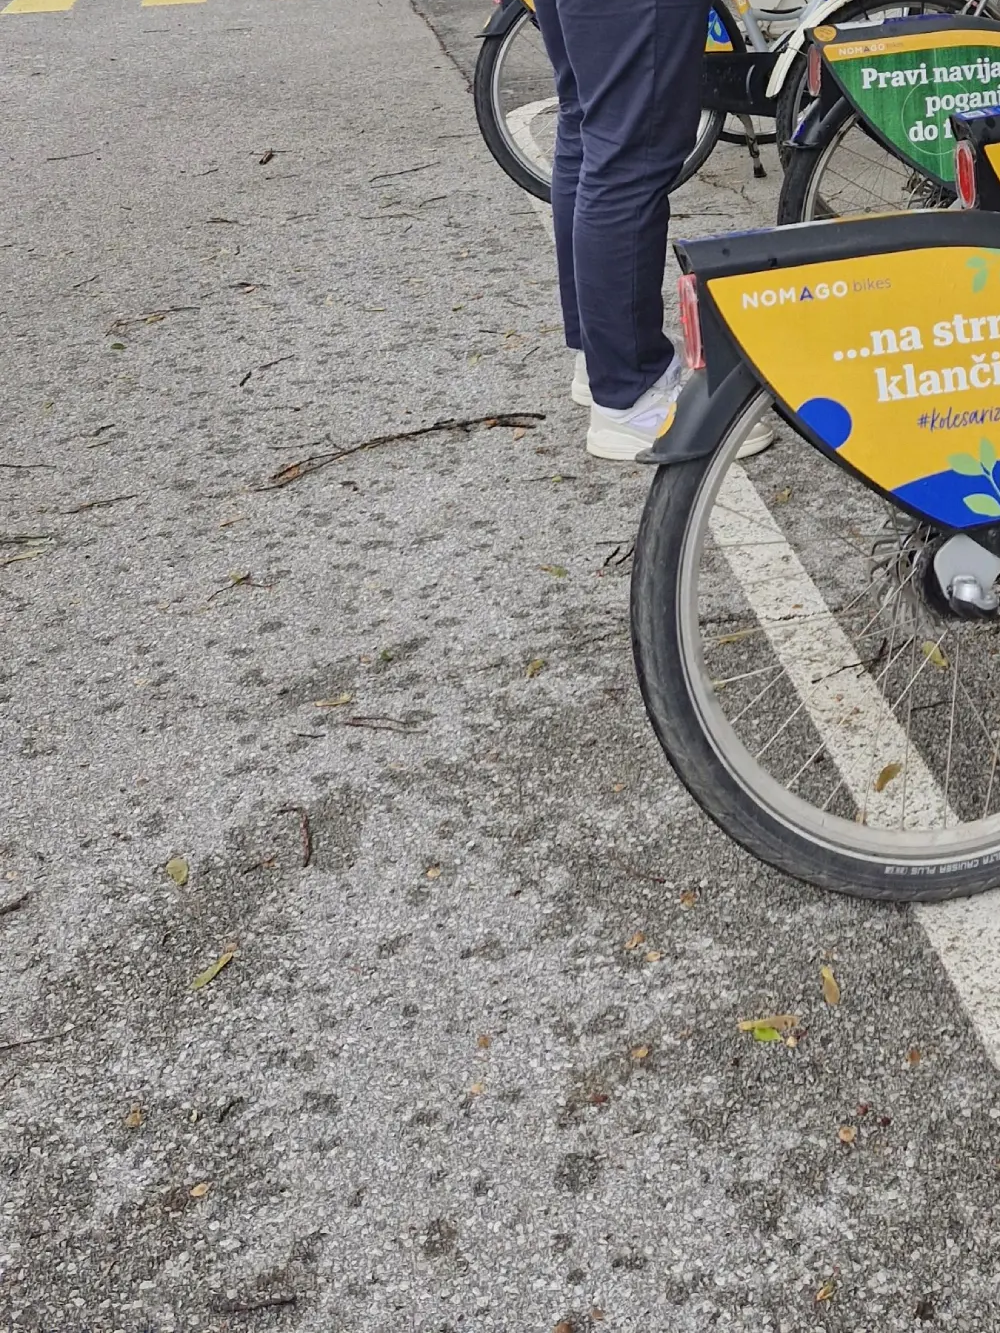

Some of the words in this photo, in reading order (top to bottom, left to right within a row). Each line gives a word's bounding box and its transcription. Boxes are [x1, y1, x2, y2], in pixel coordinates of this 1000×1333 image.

[838, 43, 885, 56] NOMAGO
[861, 63, 929, 90] Pravi
[909, 120, 938, 142] do
[742, 280, 848, 310] NOMAGO
[852, 277, 892, 293] bikes
[832, 325, 923, 362] ...na
[910, 866, 936, 876] PLUS
[939, 859, 980, 874] CRUISER
